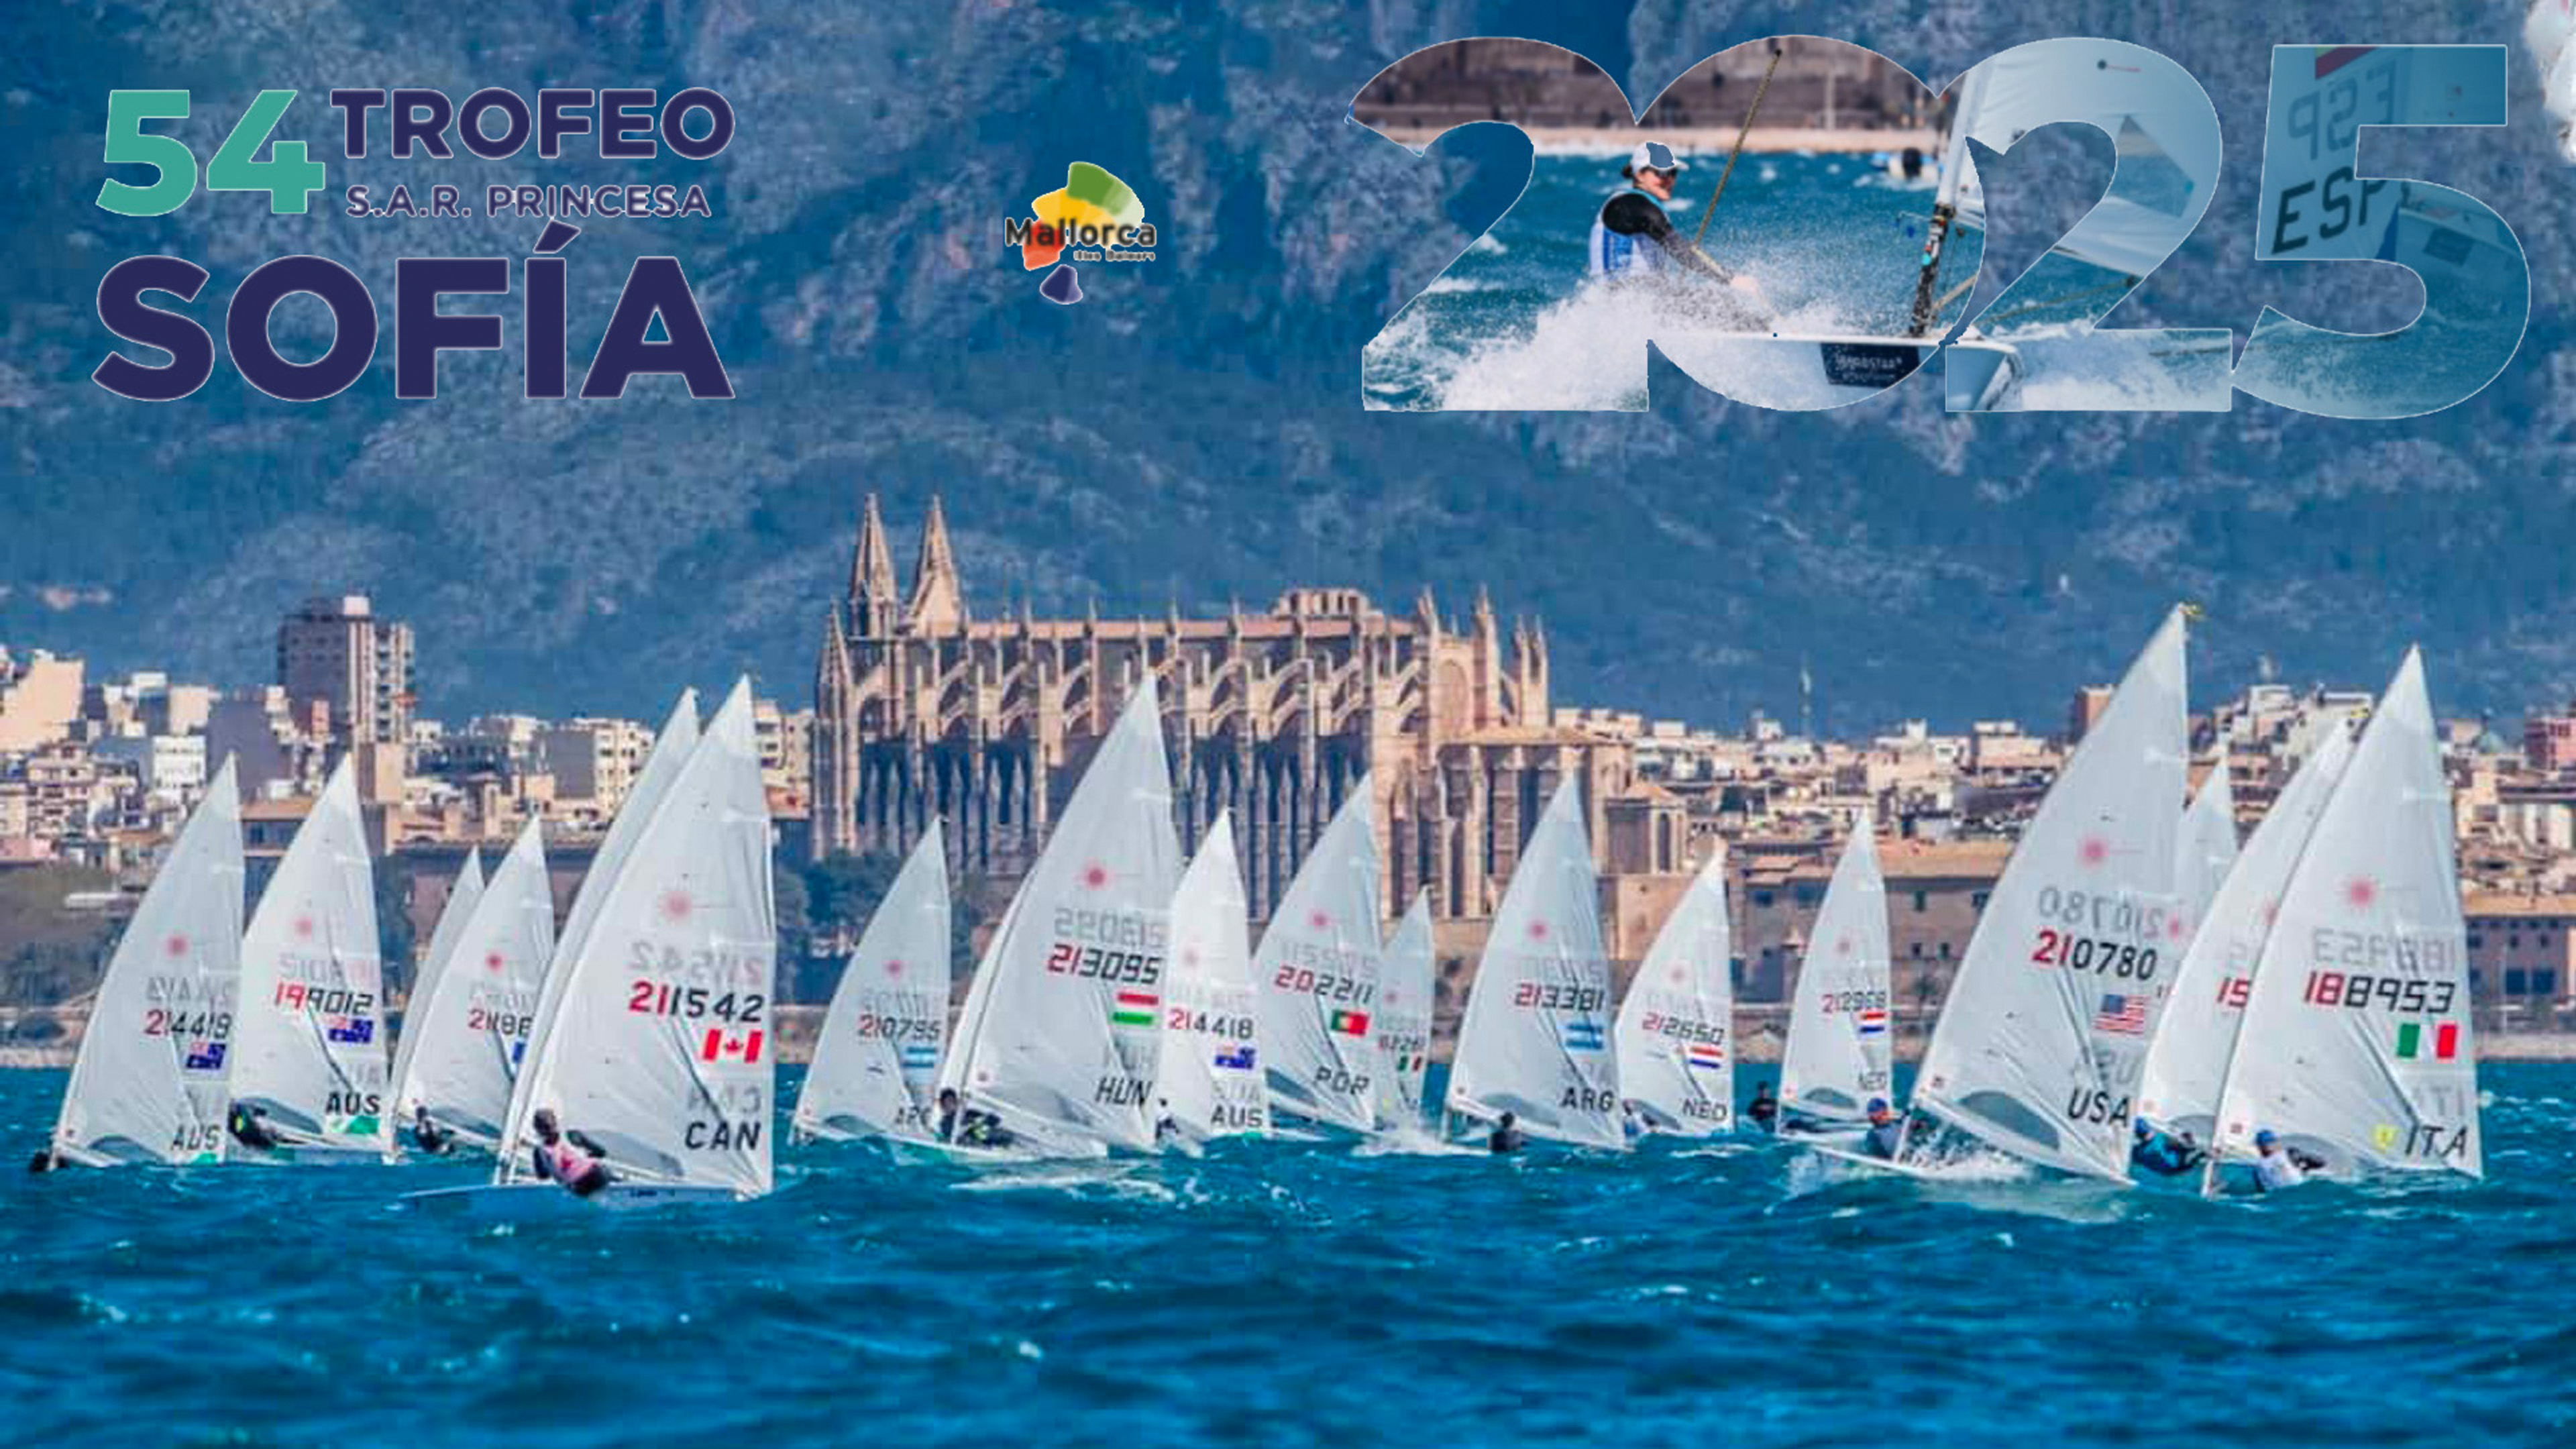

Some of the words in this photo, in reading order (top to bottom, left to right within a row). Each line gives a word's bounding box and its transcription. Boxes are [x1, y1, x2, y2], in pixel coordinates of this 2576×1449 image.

[1047, 944, 1161, 985] 213095
[2032, 930, 2157, 981] 210780
[275, 983, 374, 1015] 199012
[1275, 965, 1374, 1004] 202211
[1514, 983, 1605, 1012] 213381
[2305, 971, 2455, 1014] 188953
[629, 980, 764, 1022] 211542
[1169, 1008, 1253, 1039] 214418
[1094, 1077, 1152, 1107] HUN
[1312, 1065, 1370, 1095] POR
[325, 1091, 380, 1115] AUS
[1560, 1087, 1615, 1112] ARG
[1682, 1097, 1727, 1122] NED
[2068, 1087, 2131, 1128] USA
[1210, 1104, 1263, 1128] AUS
[170, 1124, 221, 1150] AUS
[685, 1121, 761, 1150] CAN
[2404, 1124, 2467, 1159] ITA
